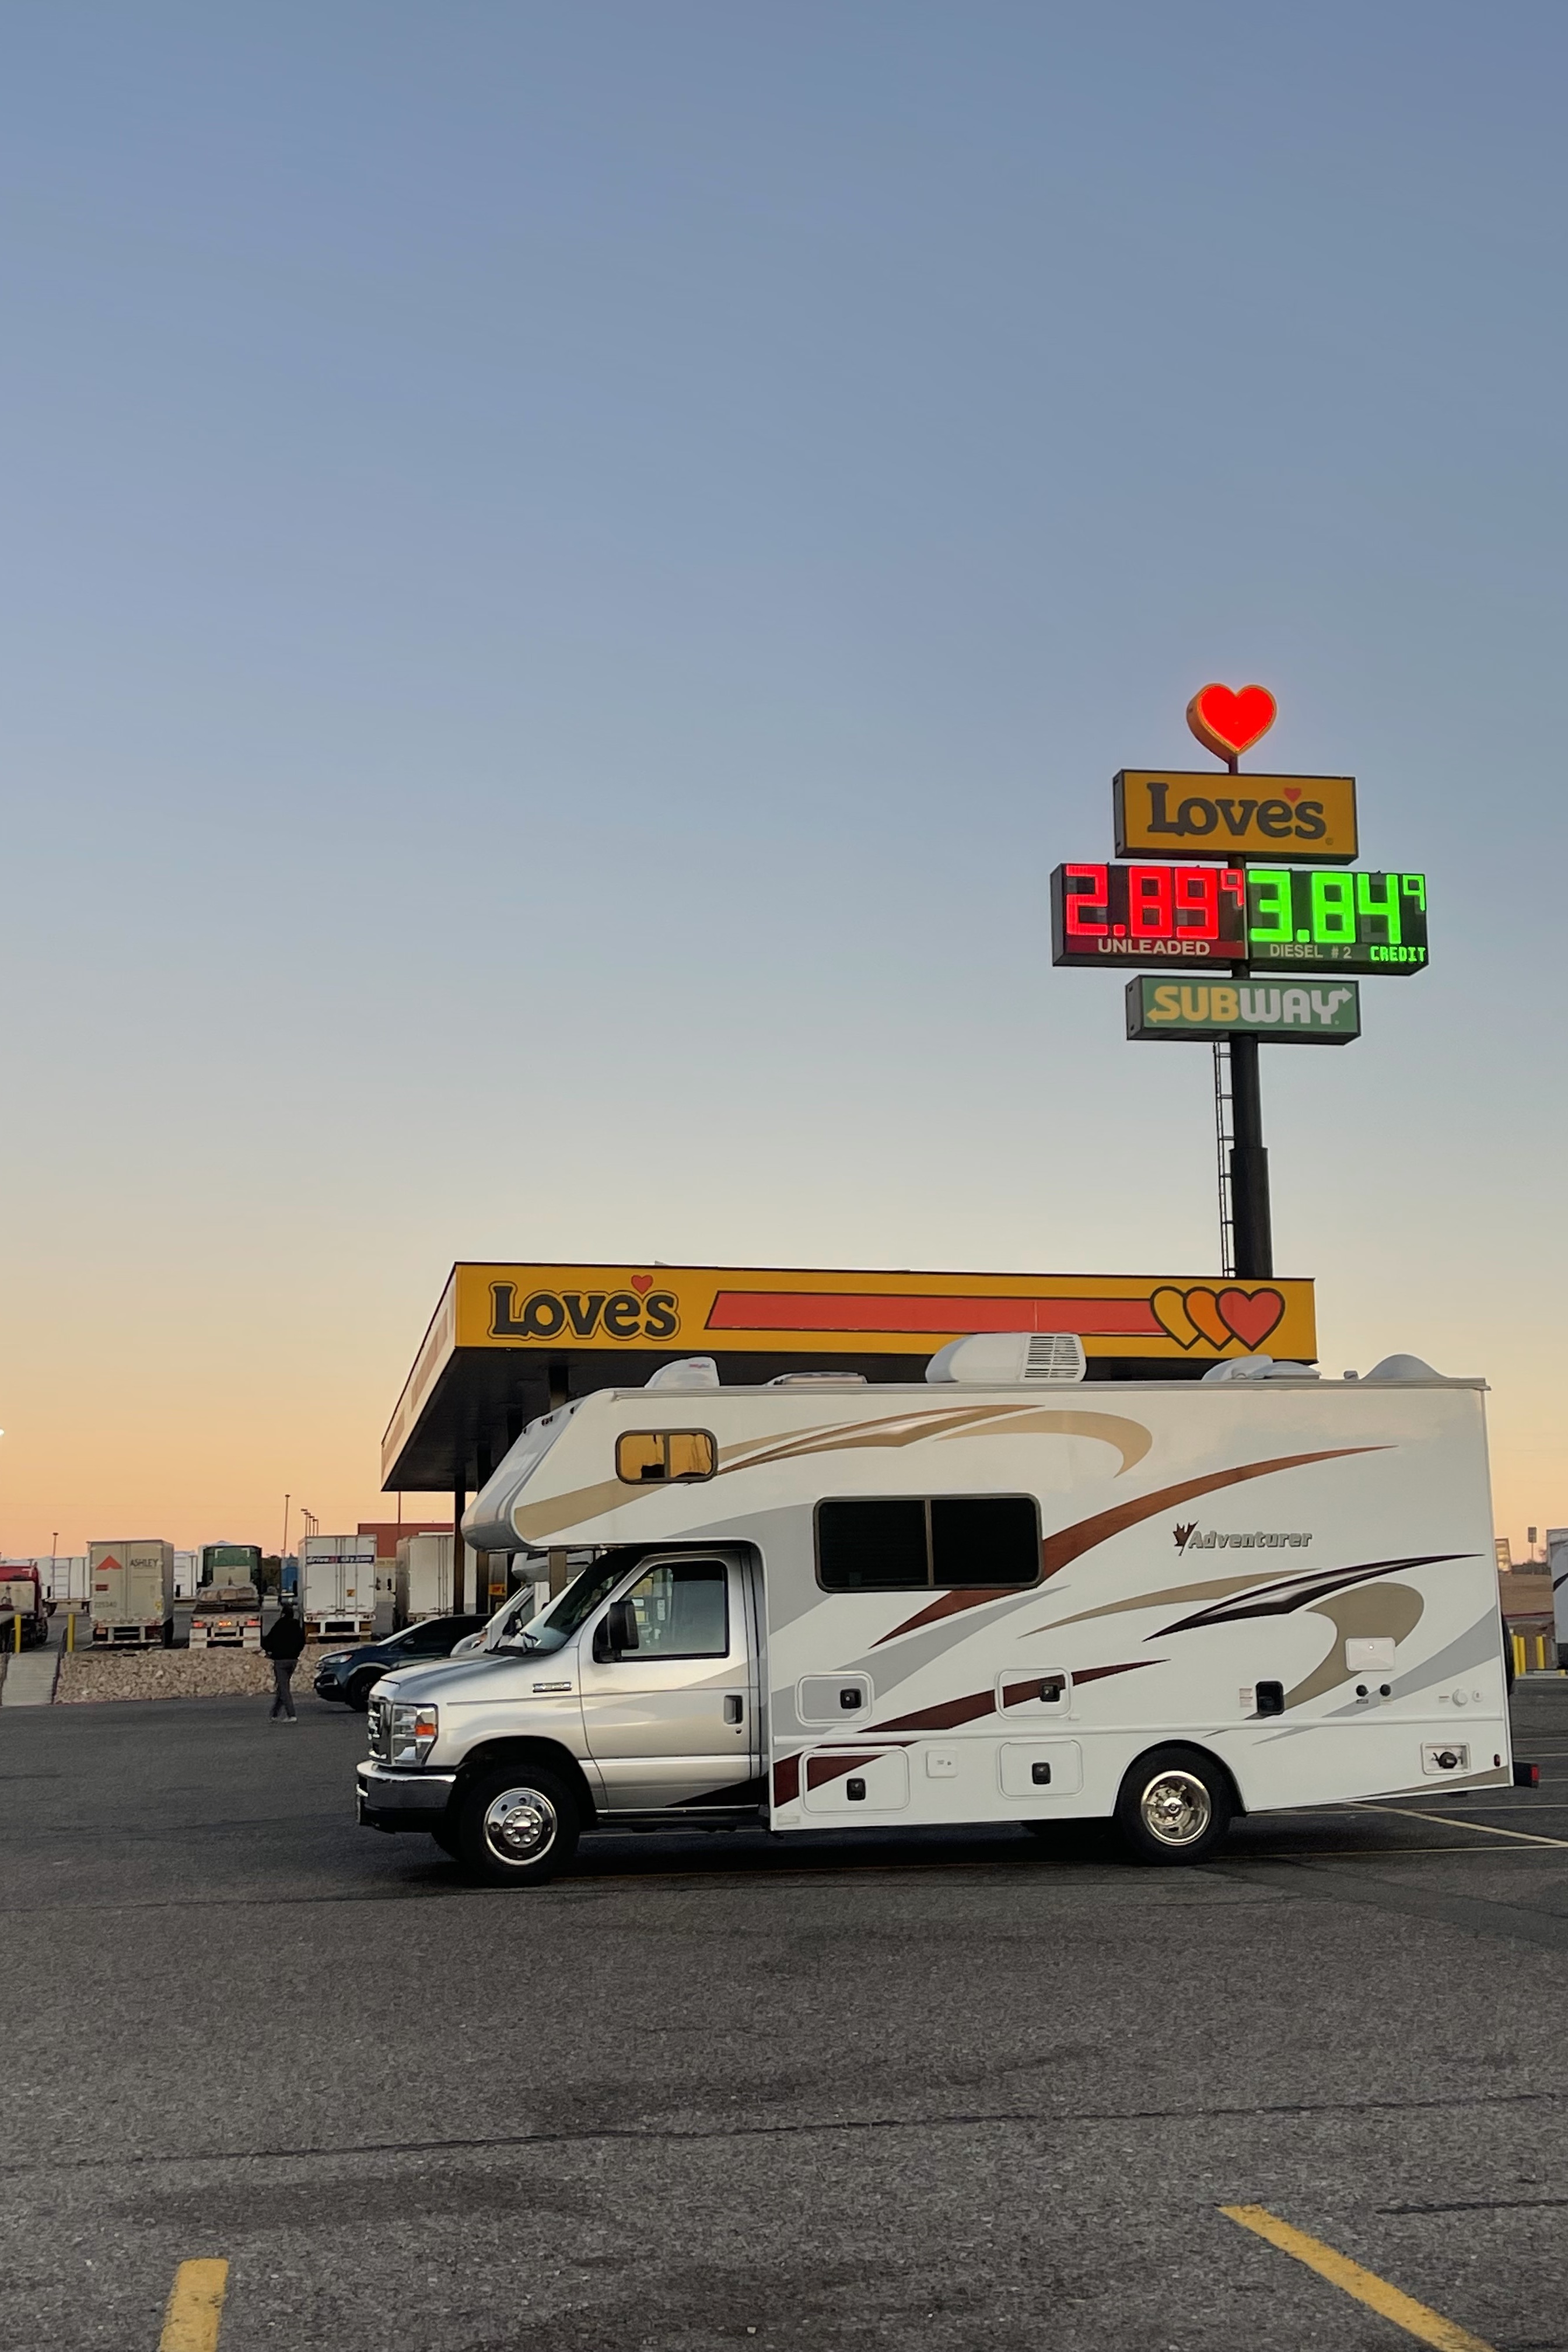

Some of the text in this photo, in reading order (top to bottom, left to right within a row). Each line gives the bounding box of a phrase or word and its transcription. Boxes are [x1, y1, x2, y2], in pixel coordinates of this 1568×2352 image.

[1098, 939, 1210, 957] UNLEADED
[1269, 944, 1323, 959] DIESEL
[1370, 946, 1426, 963] CREDIT
[1147, 986, 1352, 1025] SUBWAY
[1188, 1530, 1312, 1549] Adventurer
[130, 1558, 159, 1567] ASHLEY
